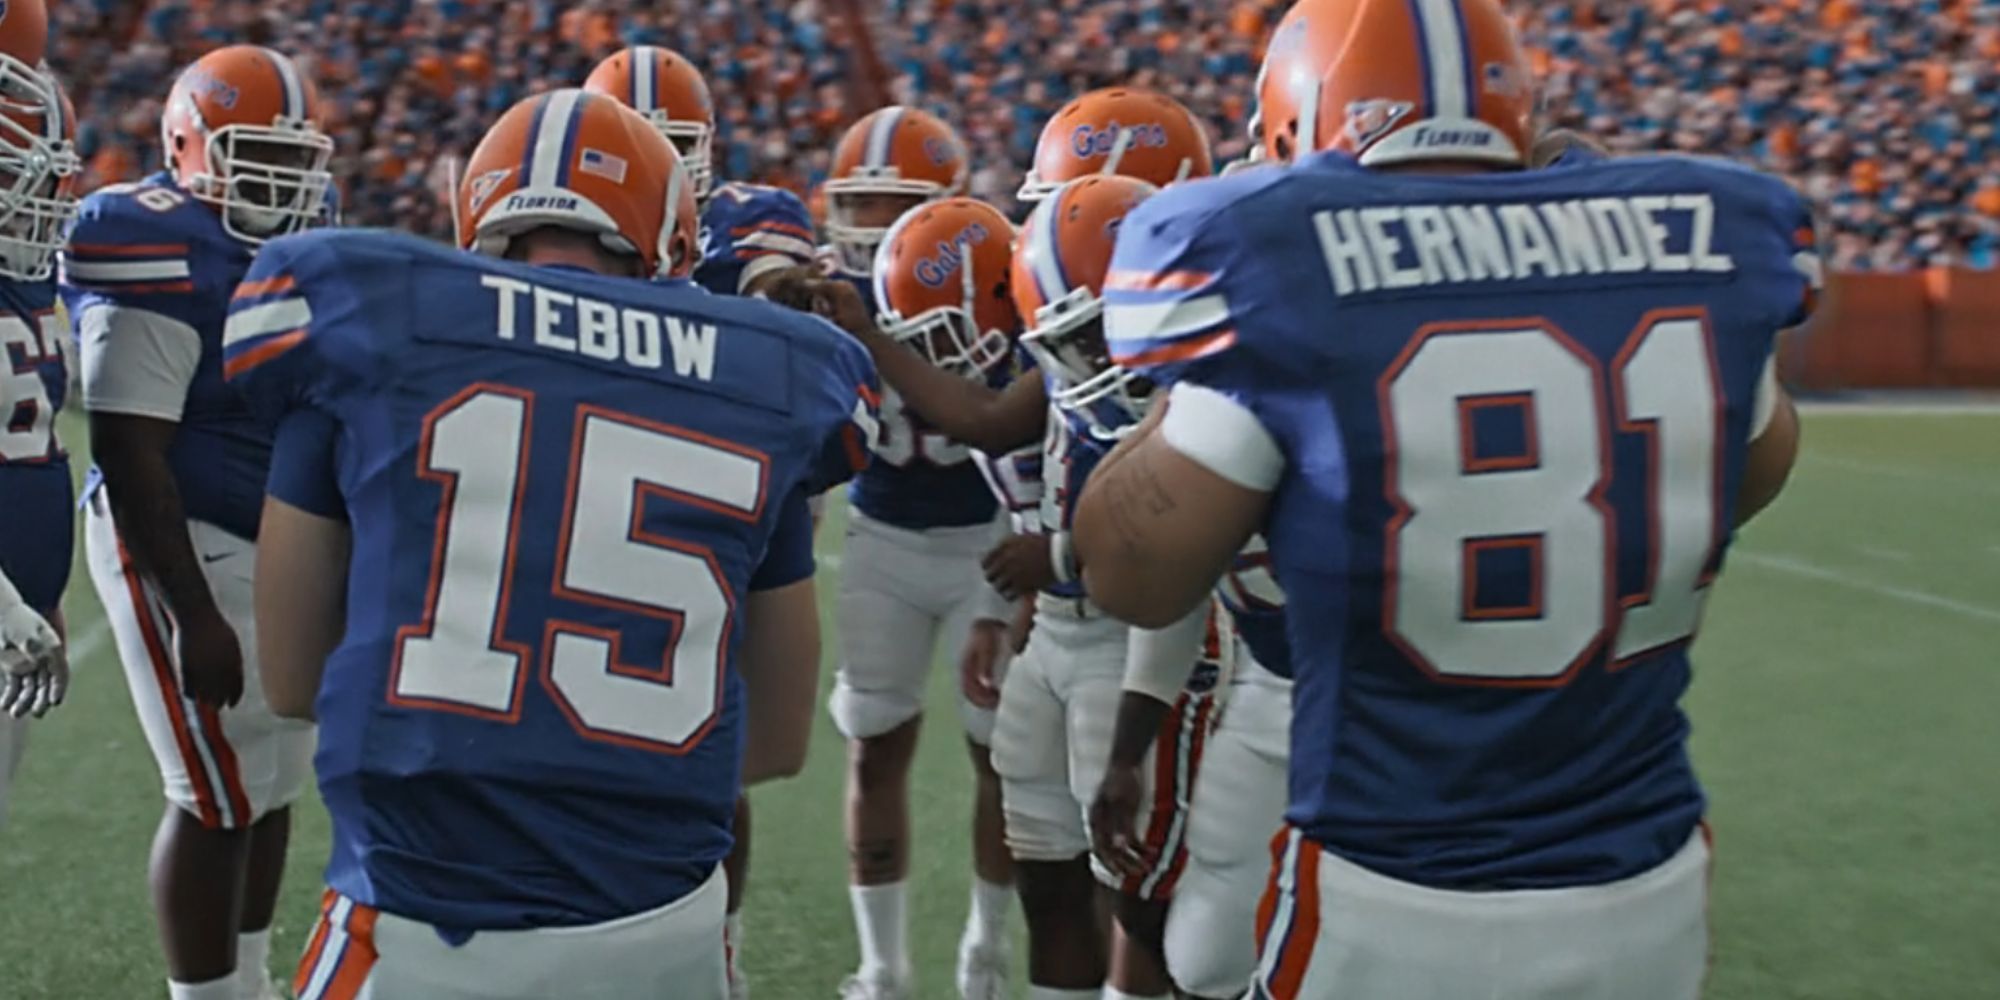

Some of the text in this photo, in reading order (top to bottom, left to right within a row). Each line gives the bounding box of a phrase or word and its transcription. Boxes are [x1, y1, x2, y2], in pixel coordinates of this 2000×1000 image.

[481, 275, 717, 381] TEBOW
[1313, 194, 1734, 295] HERNANDEZ
[387, 382, 771, 755] 15
[1376, 306, 1725, 688] 81
